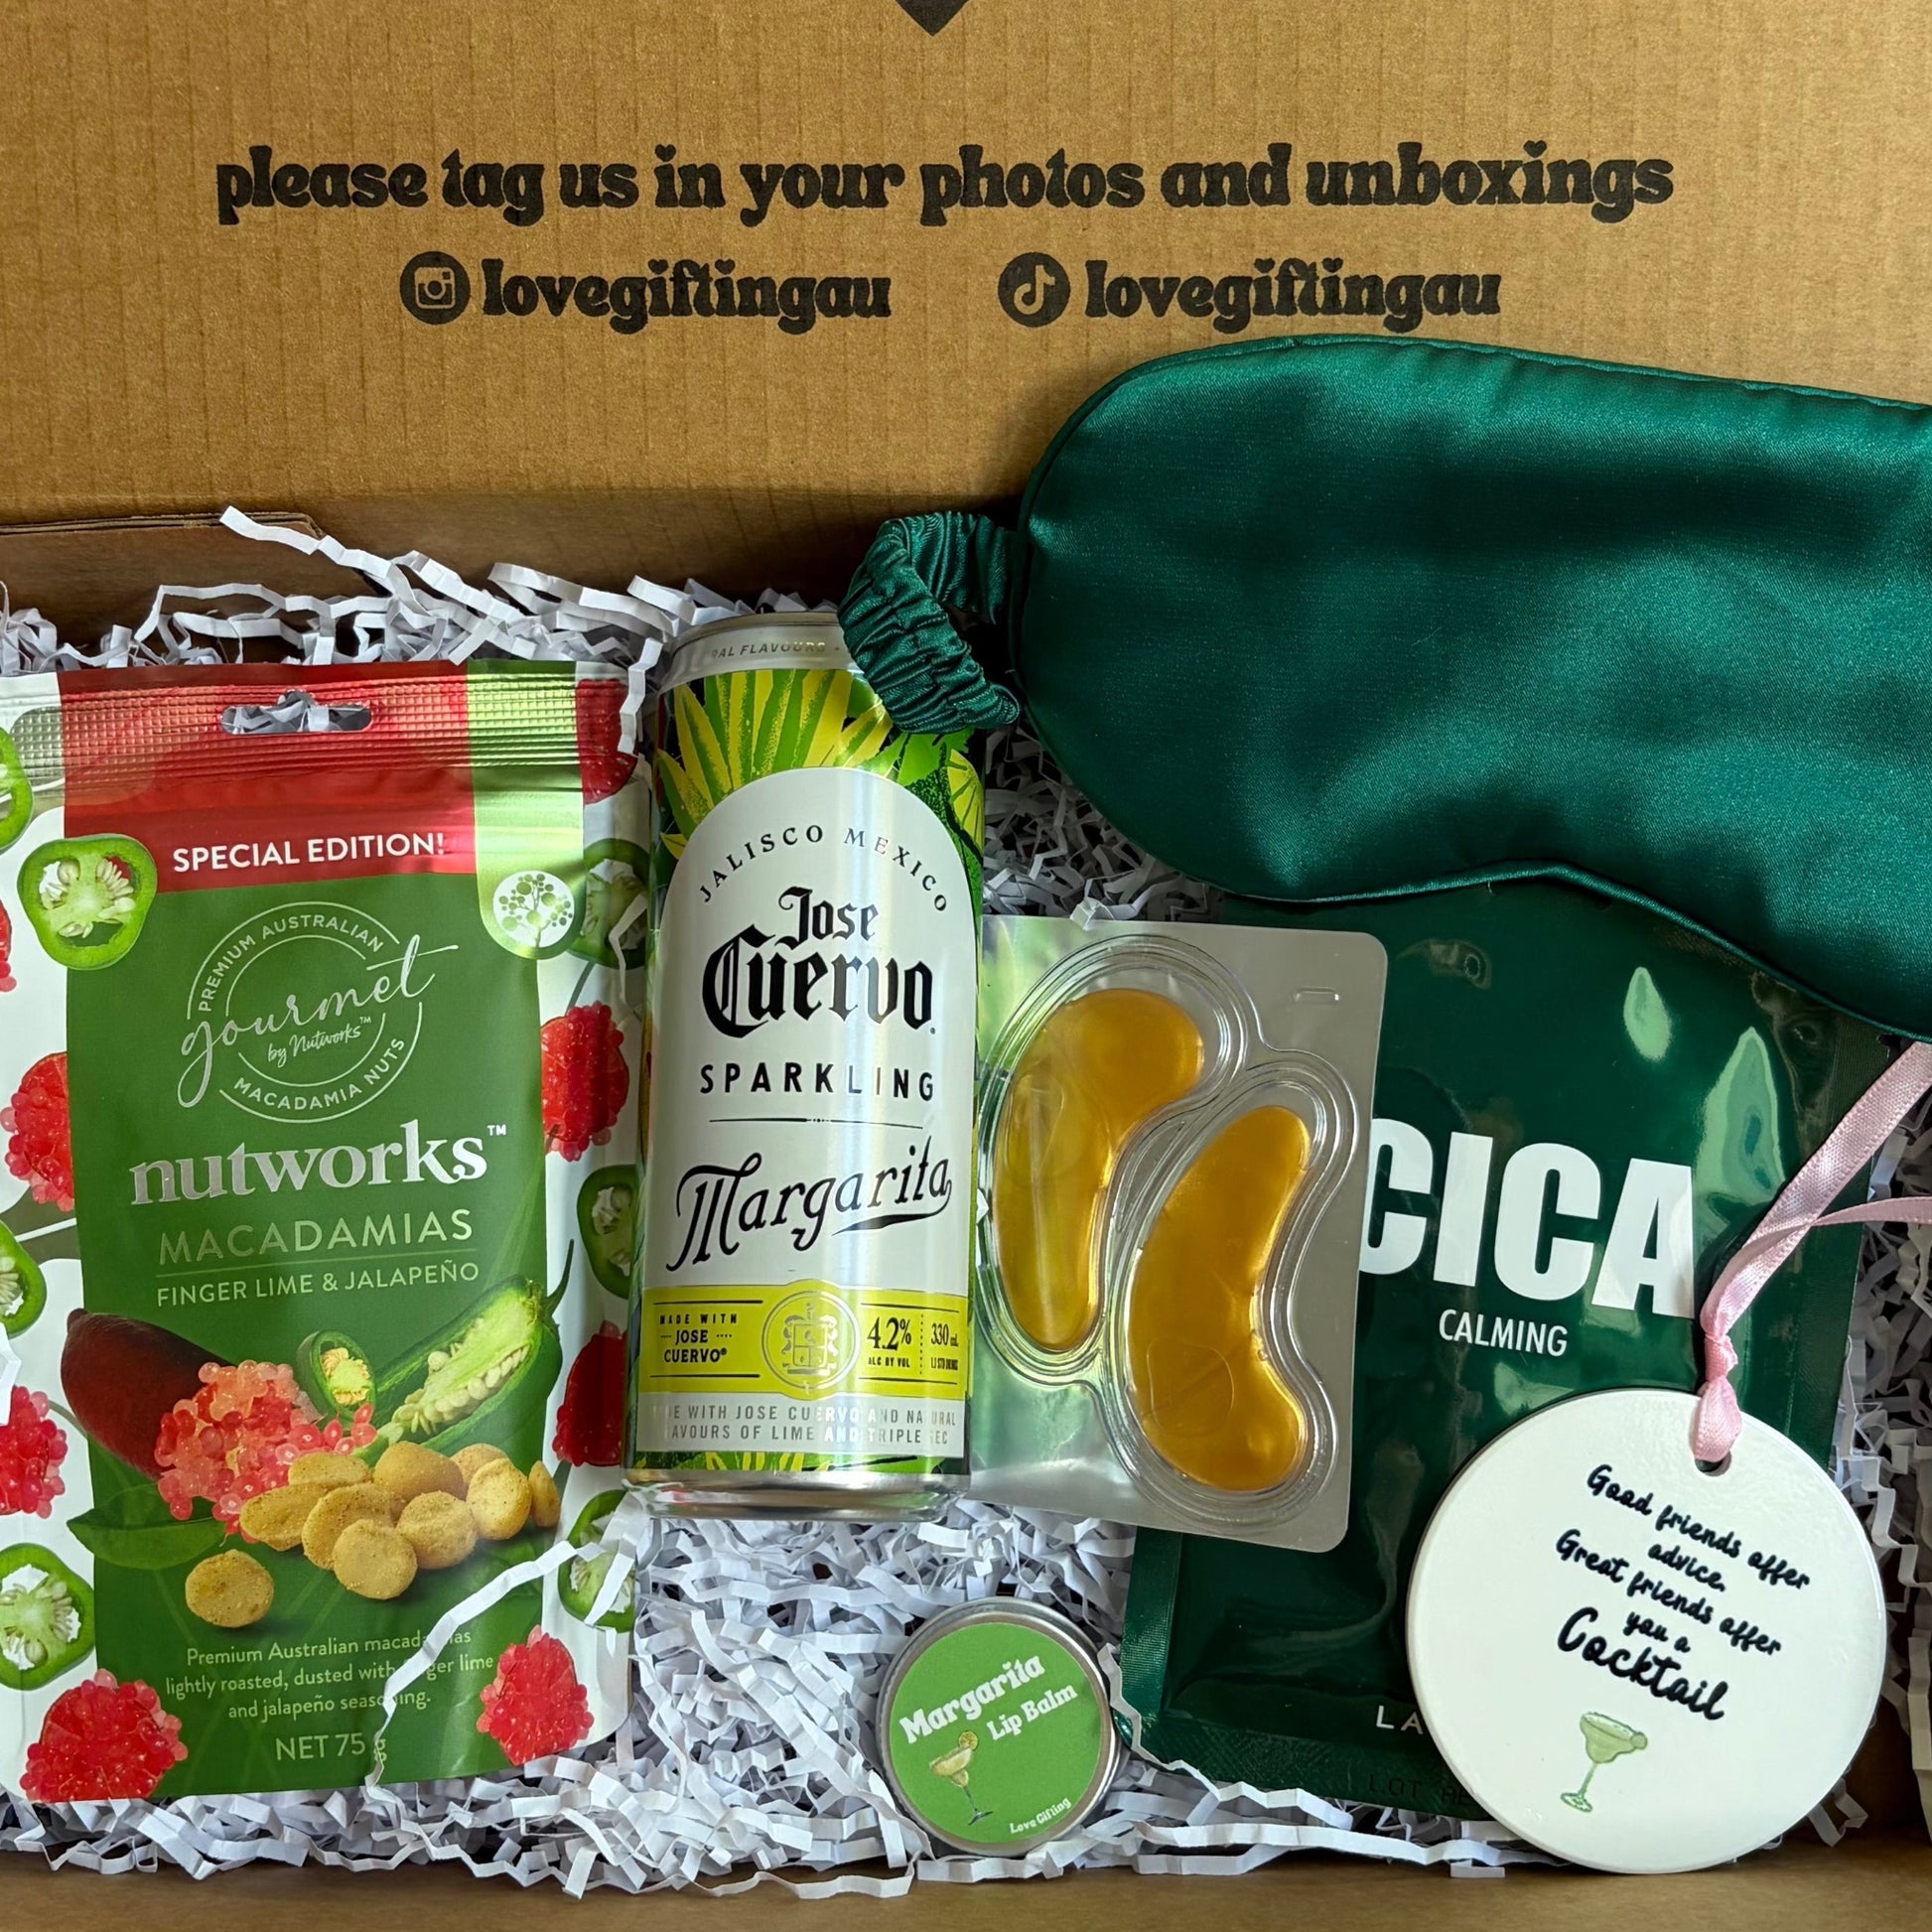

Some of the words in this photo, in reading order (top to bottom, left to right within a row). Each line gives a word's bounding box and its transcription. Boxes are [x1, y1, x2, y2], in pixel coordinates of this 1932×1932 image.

[216, 145, 429, 224] please
[442, 150, 545, 226] tag
[558, 164, 638, 207] us
[653, 144, 727, 208] in
[740, 163, 905, 227] your
[919, 144, 1145, 226] photos
[1161, 143, 1291, 207] and
[1306, 140, 1675, 223] unboxings
[482, 258, 892, 335] lovegiftingau
[1085, 258, 1501, 334] lovegiftingau
[740, 641, 826, 655] FLAVOURS
[173, 843, 300, 874] SPECIAL
[302, 832, 445, 865] EDITION!
[701, 824, 824, 903] JALISCO
[843, 826, 948, 912] MEXICO
[773, 886, 880, 951] Jose
[199, 935, 256, 1012] PREMIUM
[262, 914, 385, 952] AUSTRALIAN
[702, 923, 936, 1038] Cuervo
[178, 934, 459, 1108] gourmet
[234, 1077, 362, 1111] MACADAMIA
[363, 1037, 405, 1085] NUTS
[267, 1042, 287, 1068] by
[700, 1062, 934, 1102] SPARKLING
[666, 1136, 953, 1272] Margarita
[1359, 1118, 1695, 1319] CICA
[159, 1208, 474, 1266] MACADAMIAS
[157, 1281, 247, 1308] FINGER
[255, 1274, 314, 1298] LIME
[322, 1274, 339, 1292] &
[344, 1259, 480, 1291] JALAPEÑO
[659, 1313, 691, 1325] MADE
[700, 1313, 739, 1324] WITH
[675, 1329, 709, 1345] JOSE
[867, 1316, 912, 1351] 4.2%
[1439, 1309, 1568, 1357] CALMING
[897, 1357, 910, 1368] VOL
[665, 1424, 731, 1440] AVOURS
[740, 1426, 761, 1440] OF
[771, 1426, 815, 1441] LIME
[824, 1426, 858, 1442] AND
[867, 1427, 921, 1444] TRIPLE
[688, 1405, 727, 1420] WITH
[736, 1405, 778, 1420] JOSE
[788, 1406, 861, 1423] CUERVO
[867, 1409, 898, 1424] AND
[906, 1410, 956, 1427] NAURAL
[1587, 1464, 1654, 1516] Good
[1655, 1504, 1742, 1559] friends
[1747, 1551, 1810, 1589] offer
[1556, 1528, 1630, 1583] Great
[1626, 1571, 1715, 1624] friends
[1719, 1617, 1781, 1655] offer
[187, 1646, 263, 1666] Premium
[268, 1637, 359, 1661] Australian
[1622, 1611, 1669, 1642] you
[1673, 1636, 1691, 1653] a
[166, 1675, 216, 1701] lightly
[220, 1669, 289, 1691] roasted,
[294, 1663, 353, 1686] dusted
[460, 1653, 494, 1671] lime
[1557, 1606, 1728, 1721] Cocktail
[228, 1700, 258, 1719] and
[261, 1694, 335, 1724] jalapeño
[898, 1655, 1045, 1744] Margarita
[986, 1714, 1023, 1740] Lip
[1020, 1685, 1078, 1723] Balm
[275, 1734, 329, 1761] NET
[336, 1732, 366, 1757] 75
[1369, 1774, 1425, 1799] LOT
[1009, 1820, 1037, 1834] Love
